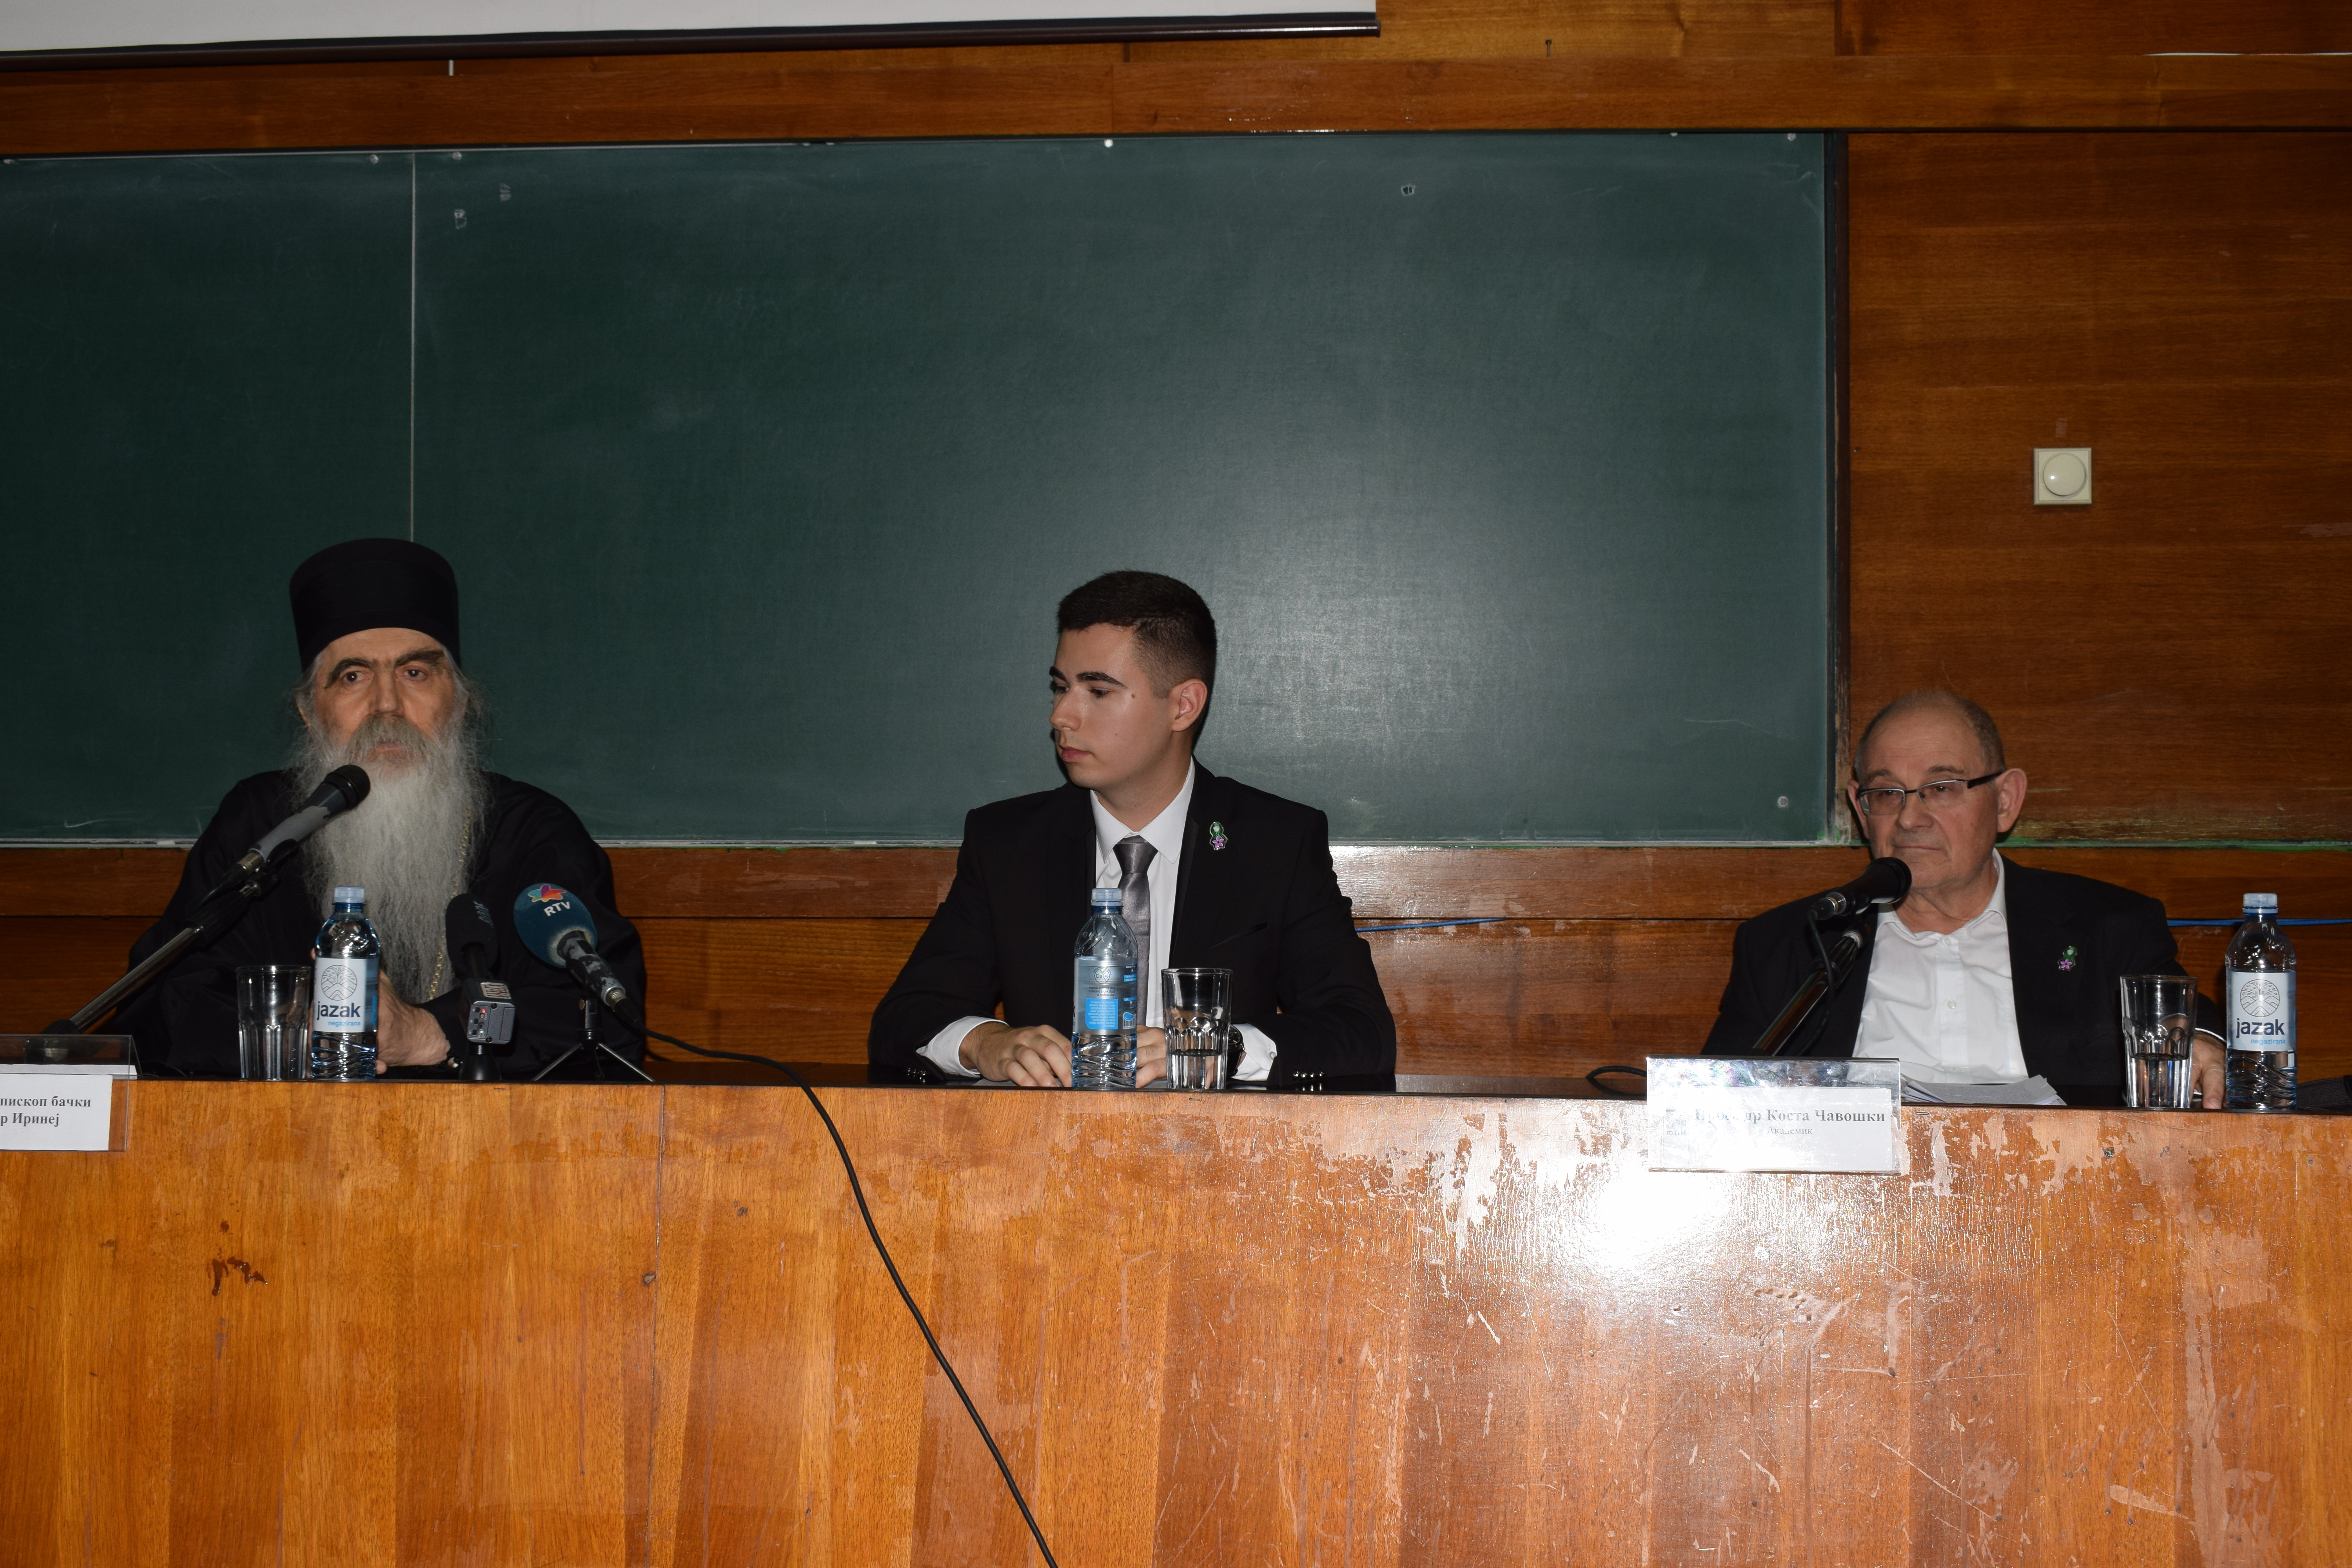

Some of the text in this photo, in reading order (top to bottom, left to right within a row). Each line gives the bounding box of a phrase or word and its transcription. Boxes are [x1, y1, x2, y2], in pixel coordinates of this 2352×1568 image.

[544, 902, 570, 916] RTV
[317, 1001, 361, 1020] jazak
[2236, 1018, 2285, 1038] jazak
[51, 1096, 91, 1107] бачки
[12, 1112, 59, 1127] Иринеј
[1766, 1109, 1809, 1121] Коста
[1814, 1109, 1885, 1121] Чавошки
